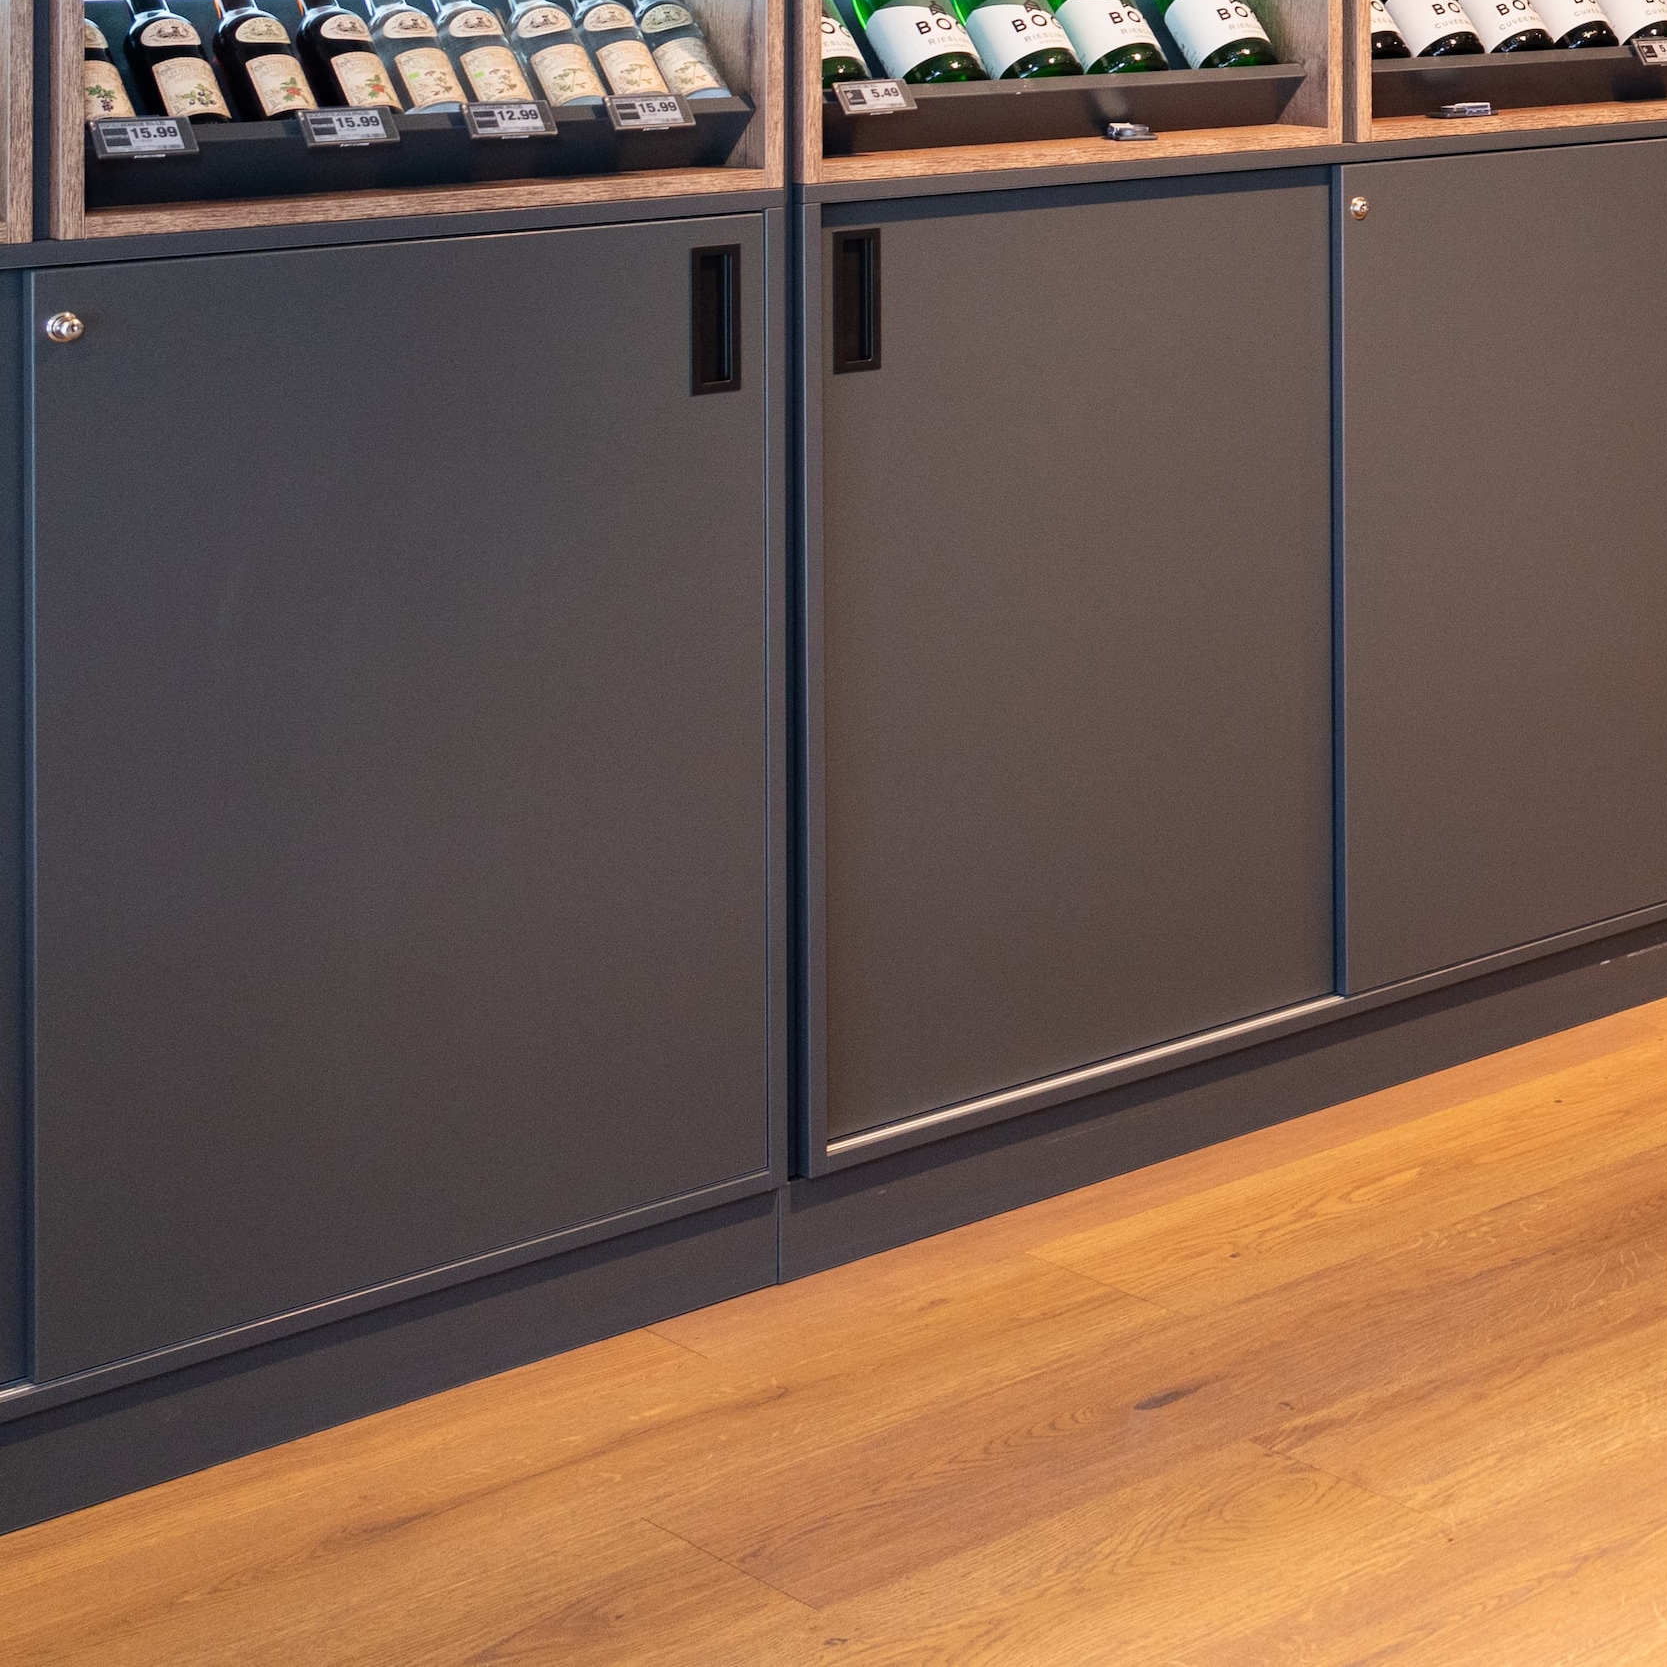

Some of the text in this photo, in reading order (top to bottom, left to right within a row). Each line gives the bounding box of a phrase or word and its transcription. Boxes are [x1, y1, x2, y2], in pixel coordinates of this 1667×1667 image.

[1217, 5, 1253, 21] BO
[1431, 1, 1461, 15] BO
[1496, 0, 1533, 16] BO
[1109, 10, 1142, 24] BO
[871, 88, 900, 99] 5.49
[497, 108, 539, 121] 12.99
[638, 101, 677, 114] 15.99
[335, 115, 380, 129] 15.99
[130, 125, 178, 140] 15.99
